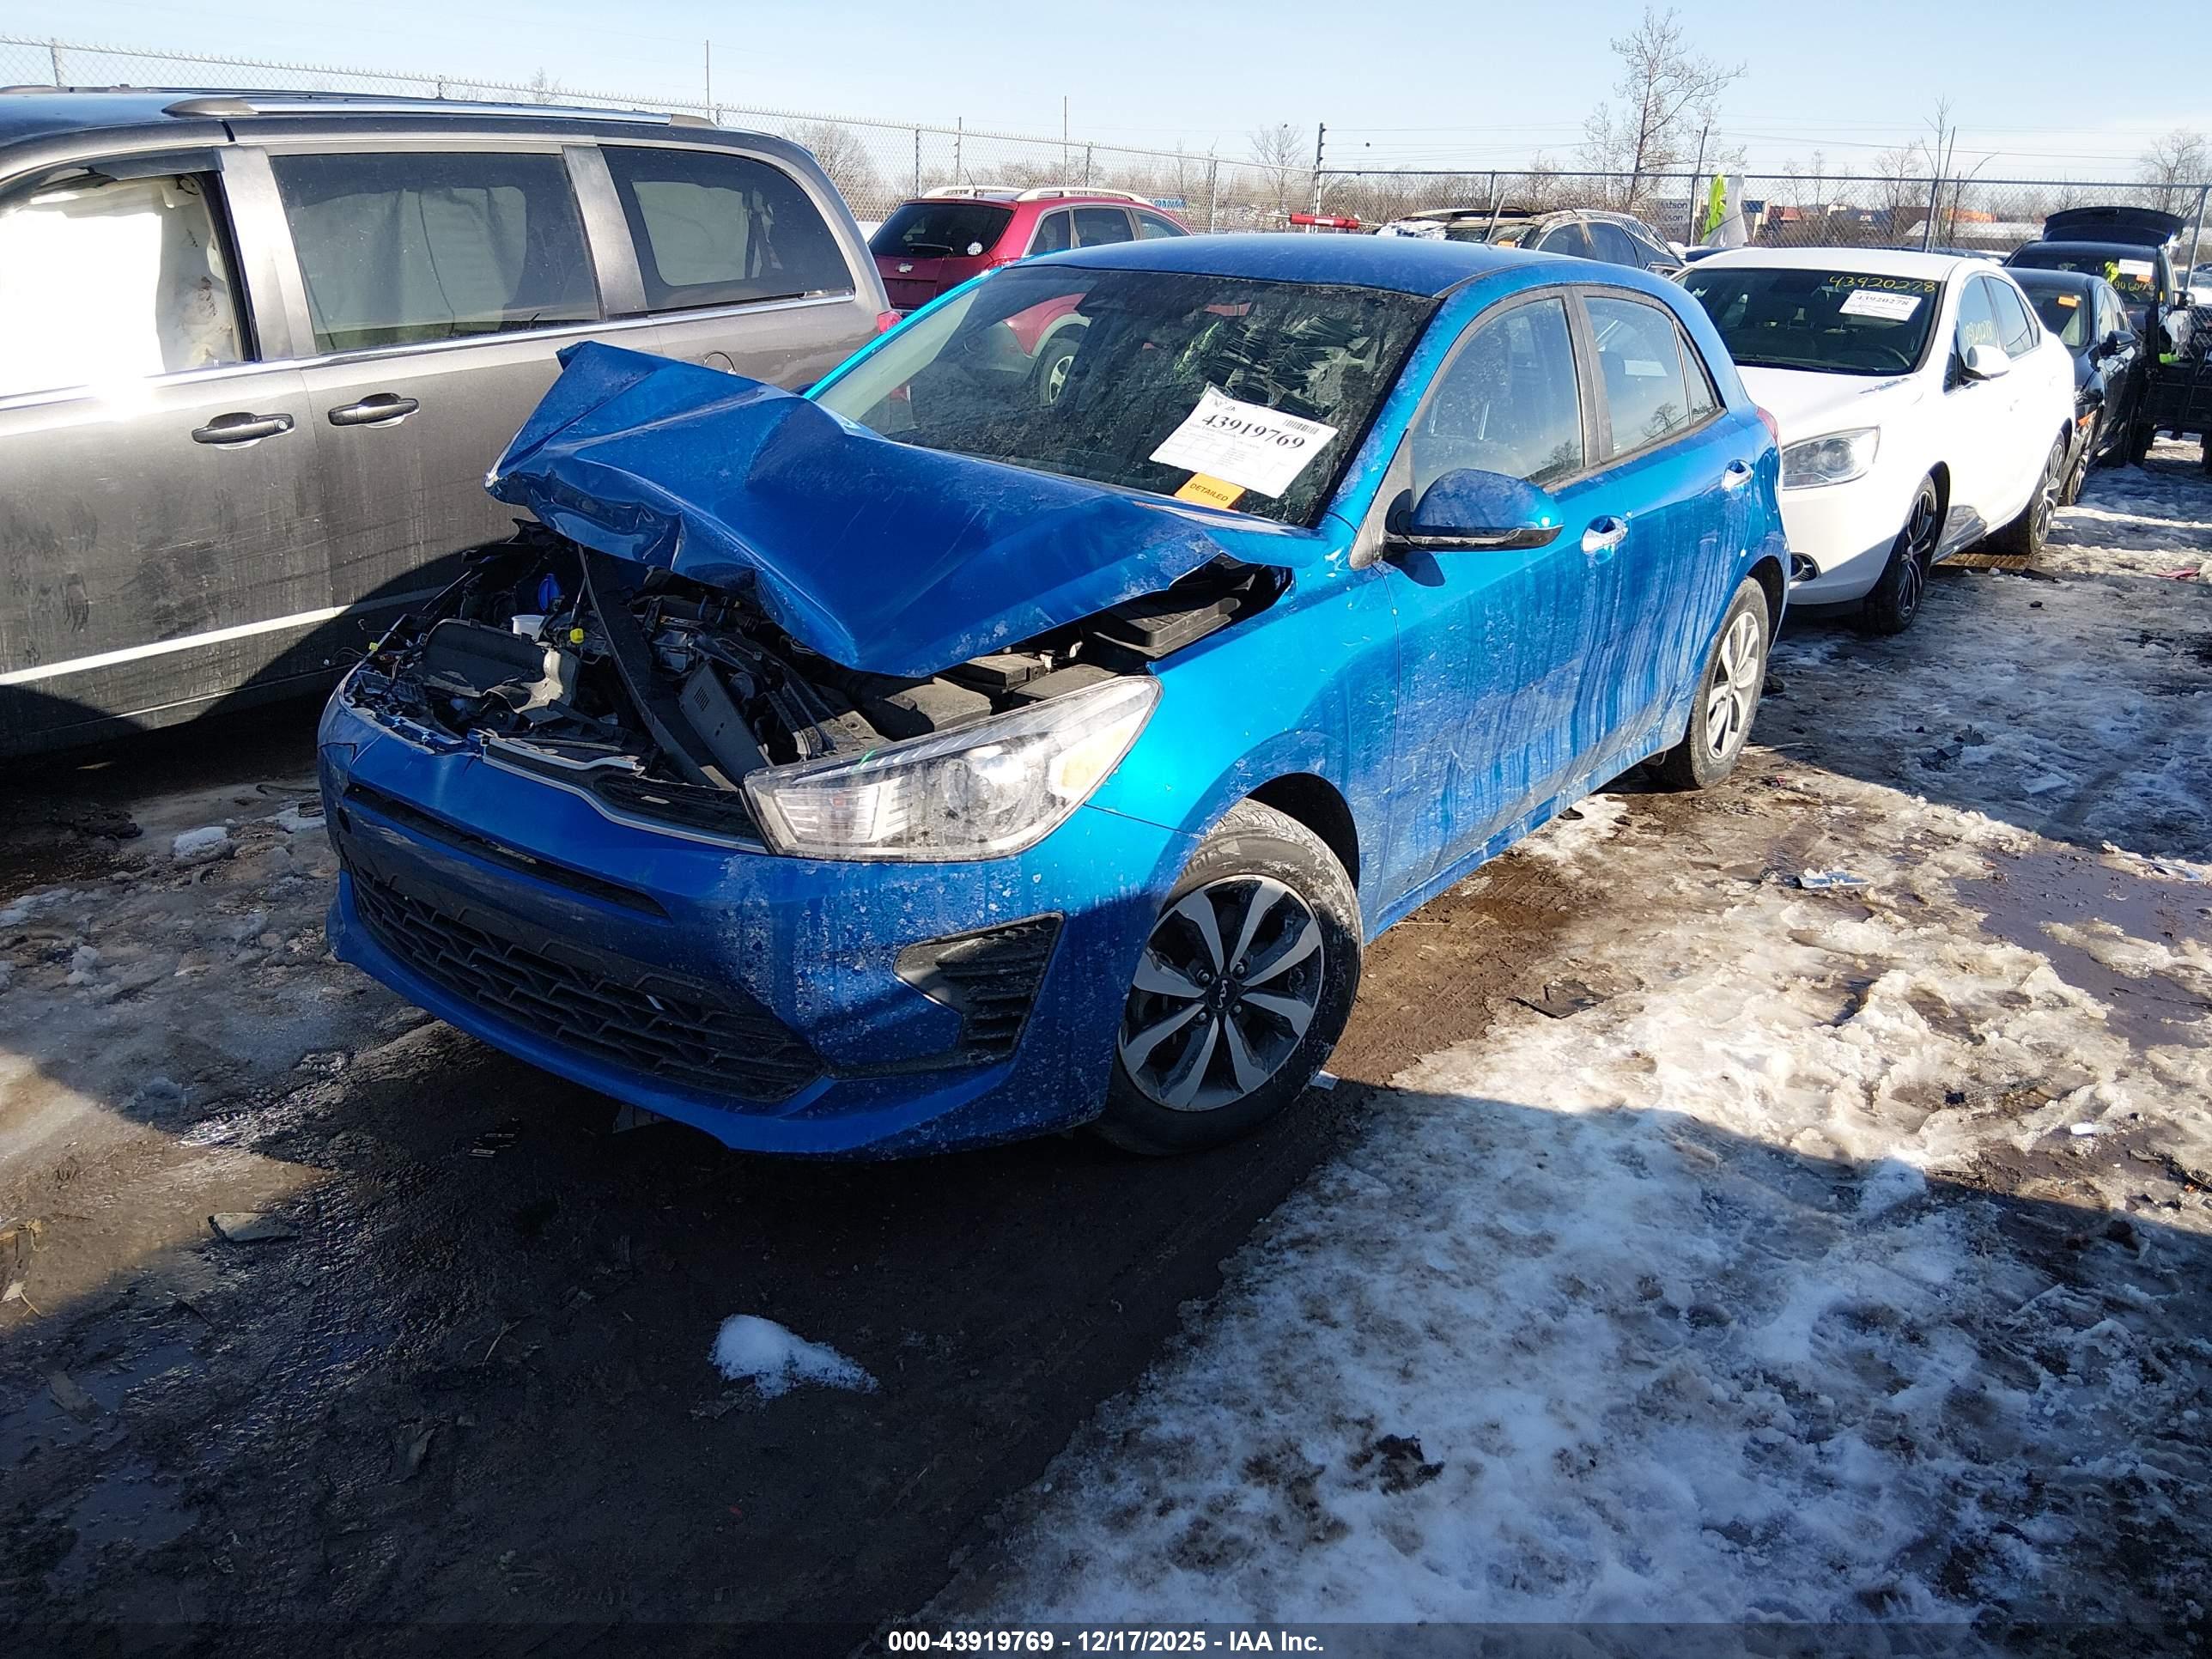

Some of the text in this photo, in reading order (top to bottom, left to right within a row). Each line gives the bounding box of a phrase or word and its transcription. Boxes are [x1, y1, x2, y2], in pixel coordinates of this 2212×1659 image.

[1829, 275, 1936, 293] 43920278
[1201, 414, 1306, 449] 43919769
[1189, 482, 1229, 502] DETAILED
